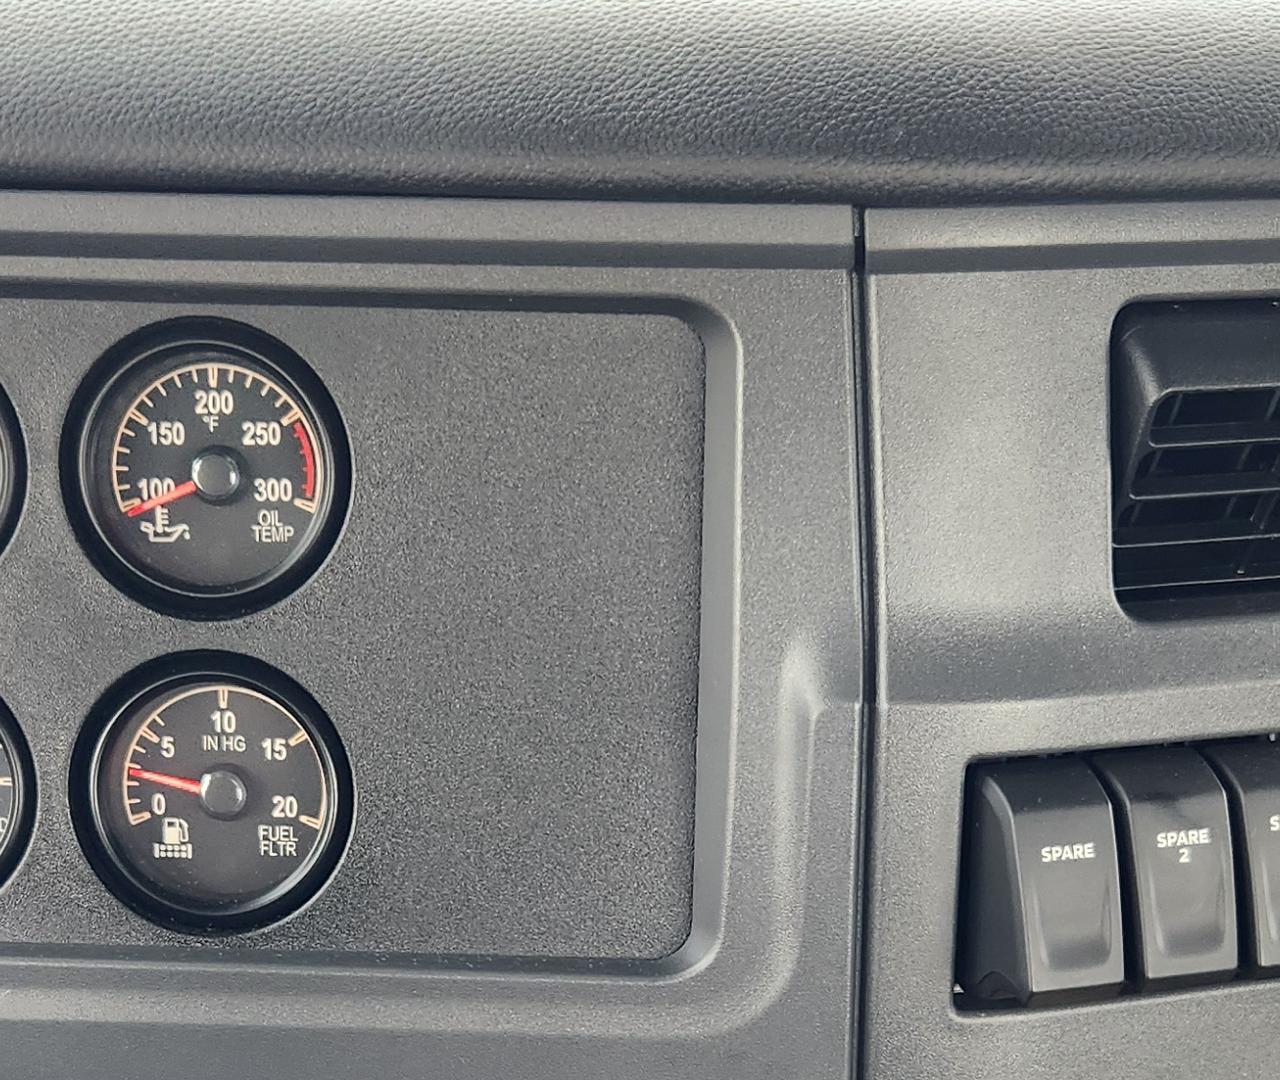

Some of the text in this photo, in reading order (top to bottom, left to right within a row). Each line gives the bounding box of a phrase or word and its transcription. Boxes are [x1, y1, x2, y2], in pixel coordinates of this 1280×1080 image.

[195, 390, 234, 414] 200
[148, 422, 185, 445] 150
[242, 422, 281, 446] 250
[138, 478, 176, 501] 100
[254, 478, 292, 502] 300
[258, 510, 282, 526] OIL
[252, 525, 294, 542] TEMP
[210, 711, 236, 733] 10
[160, 737, 175, 758] 5
[202, 736, 246, 752] IN HG
[262, 739, 287, 760] 15
[151, 793, 166, 815] 0
[272, 796, 298, 818] 20
[258, 825, 298, 842] FUEL
[1156, 828, 1211, 848] SPARE
[260, 842, 297, 856] FLTR
[1040, 842, 1096, 863] SPARE
[1178, 848, 1191, 864] 2
